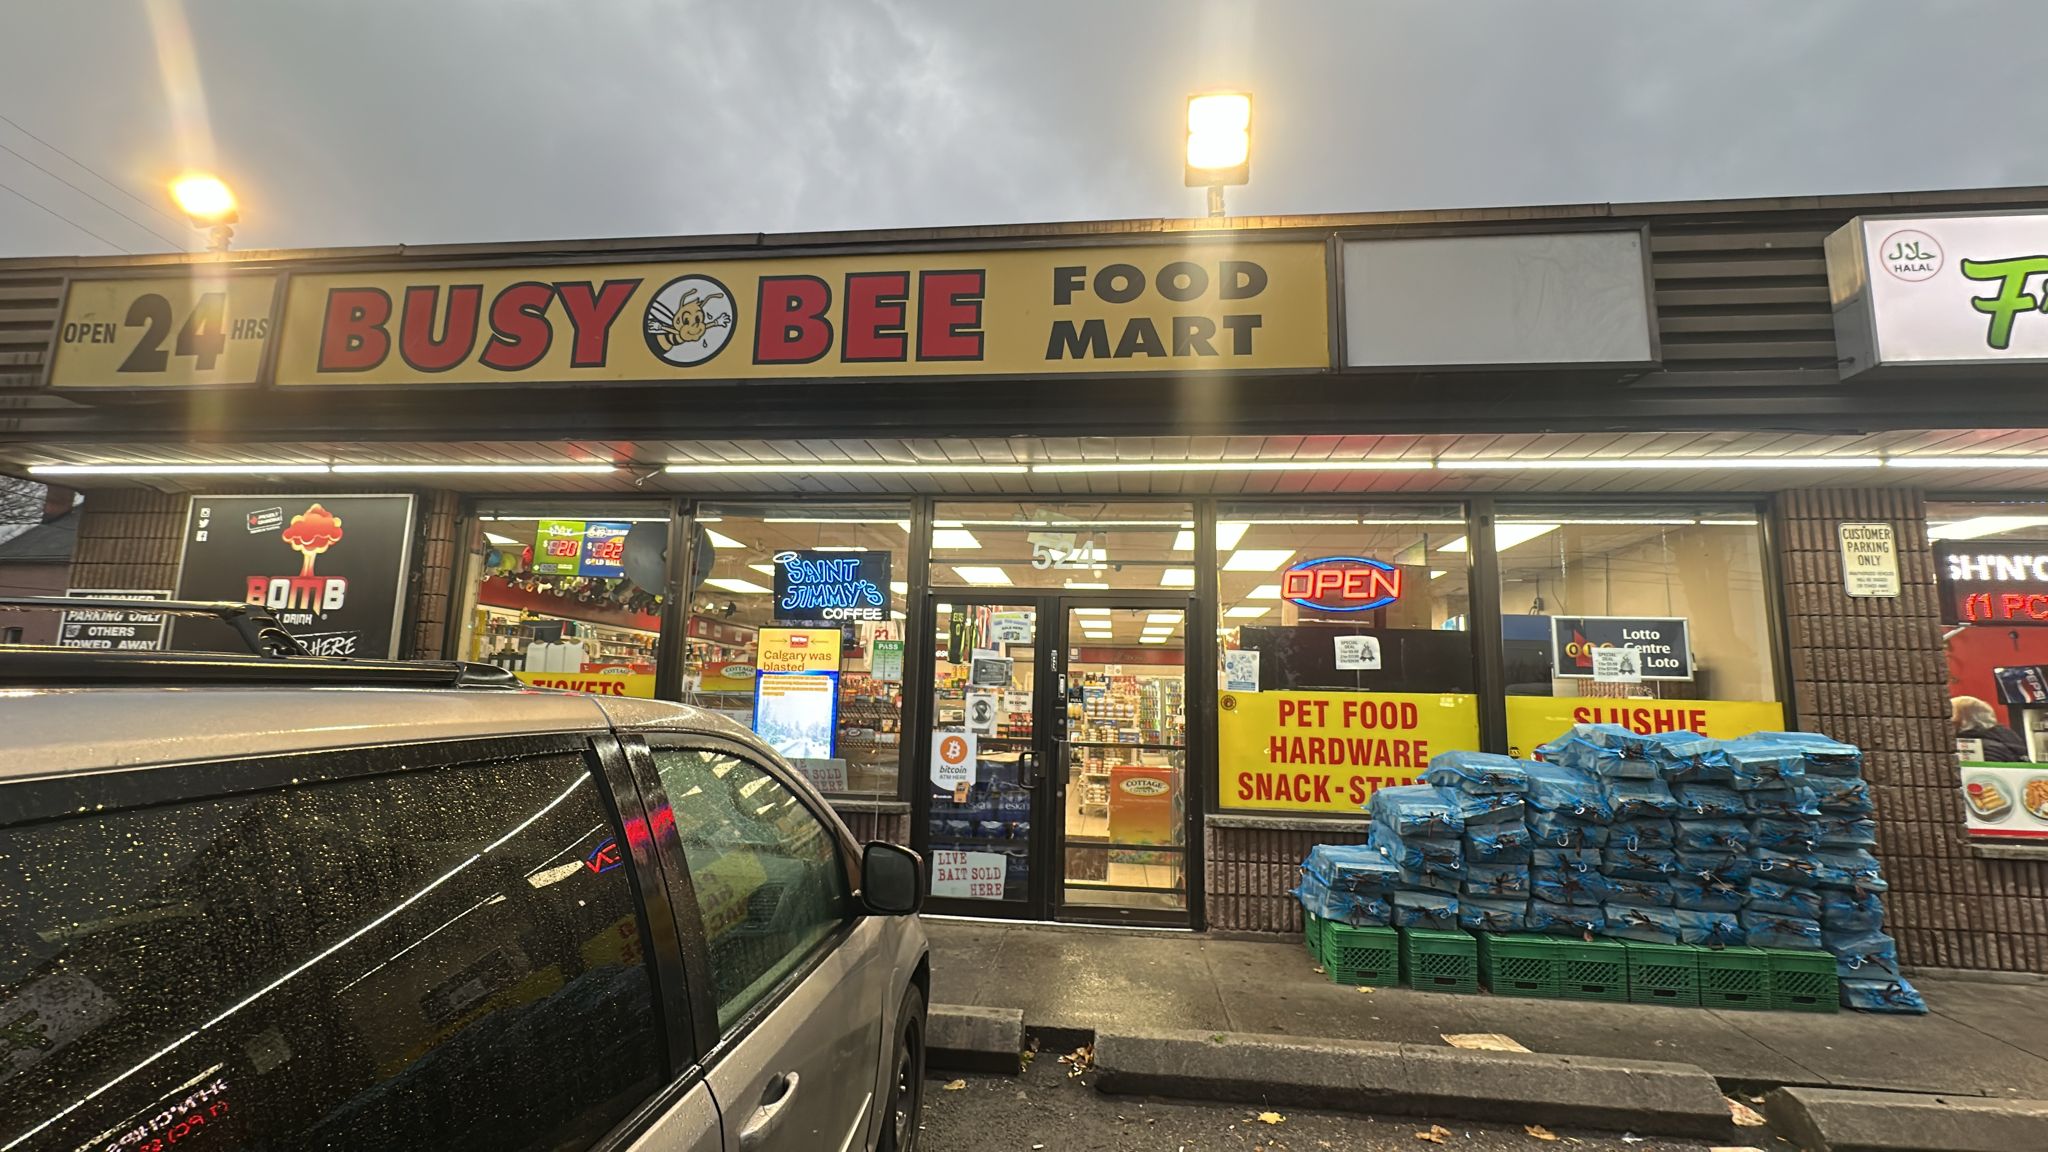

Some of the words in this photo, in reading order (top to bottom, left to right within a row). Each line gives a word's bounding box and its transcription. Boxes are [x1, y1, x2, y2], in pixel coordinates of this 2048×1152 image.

[1889, 241, 1936, 261] حلال
[1894, 263, 1934, 273] HALAL
[1053, 260, 1268, 306] FOOD
[1960, 255, 2048, 350] F
[316, 277, 644, 373] BUSY
[752, 269, 986, 366] BEE
[63, 322, 117, 344] OPEN
[116, 292, 227, 373] 24
[230, 318, 269, 341] HRS
[1045, 314, 1262, 360] MART
[1842, 528, 1891, 540] CUSTOMER
[1847, 541, 1889, 553] PARKING
[1032, 540, 1096, 570] 524
[1857, 554, 1881, 566] ONLY
[784, 554, 860, 584] SAINT
[1281, 568, 1402, 599] OPEN
[246, 576, 347, 616] BOMB
[782, 580, 884, 610] JIMMY'S
[67, 611, 124, 622] PARKING
[283, 613, 313, 625] DRINK
[822, 608, 883, 620] COFFEE
[88, 627, 136, 637] OTHERS
[1623, 629, 1661, 640] Lotto
[62, 639, 112, 649] TOWED
[117, 641, 158, 650] AWAY
[310, 636, 357, 656] HERE
[764, 650, 807, 662] Calgary
[809, 653, 832, 661] was
[1647, 656, 1679, 668] Loto
[763, 662, 805, 672] blasted
[532, 679, 626, 697] KETS
[1278, 700, 1330, 727] PET
[1343, 701, 1419, 730] FOOD
[1269, 735, 1429, 769] HARDWARE
[813, 769, 841, 780] SOLD
[939, 765, 967, 774] bitcoin
[1126, 780, 1163, 789] COTTAGE
[938, 852, 967, 865] LIVE
[938, 868, 968, 881] BAIT
[971, 867, 1002, 880] SOLD
[971, 883, 1003, 896] HERE
